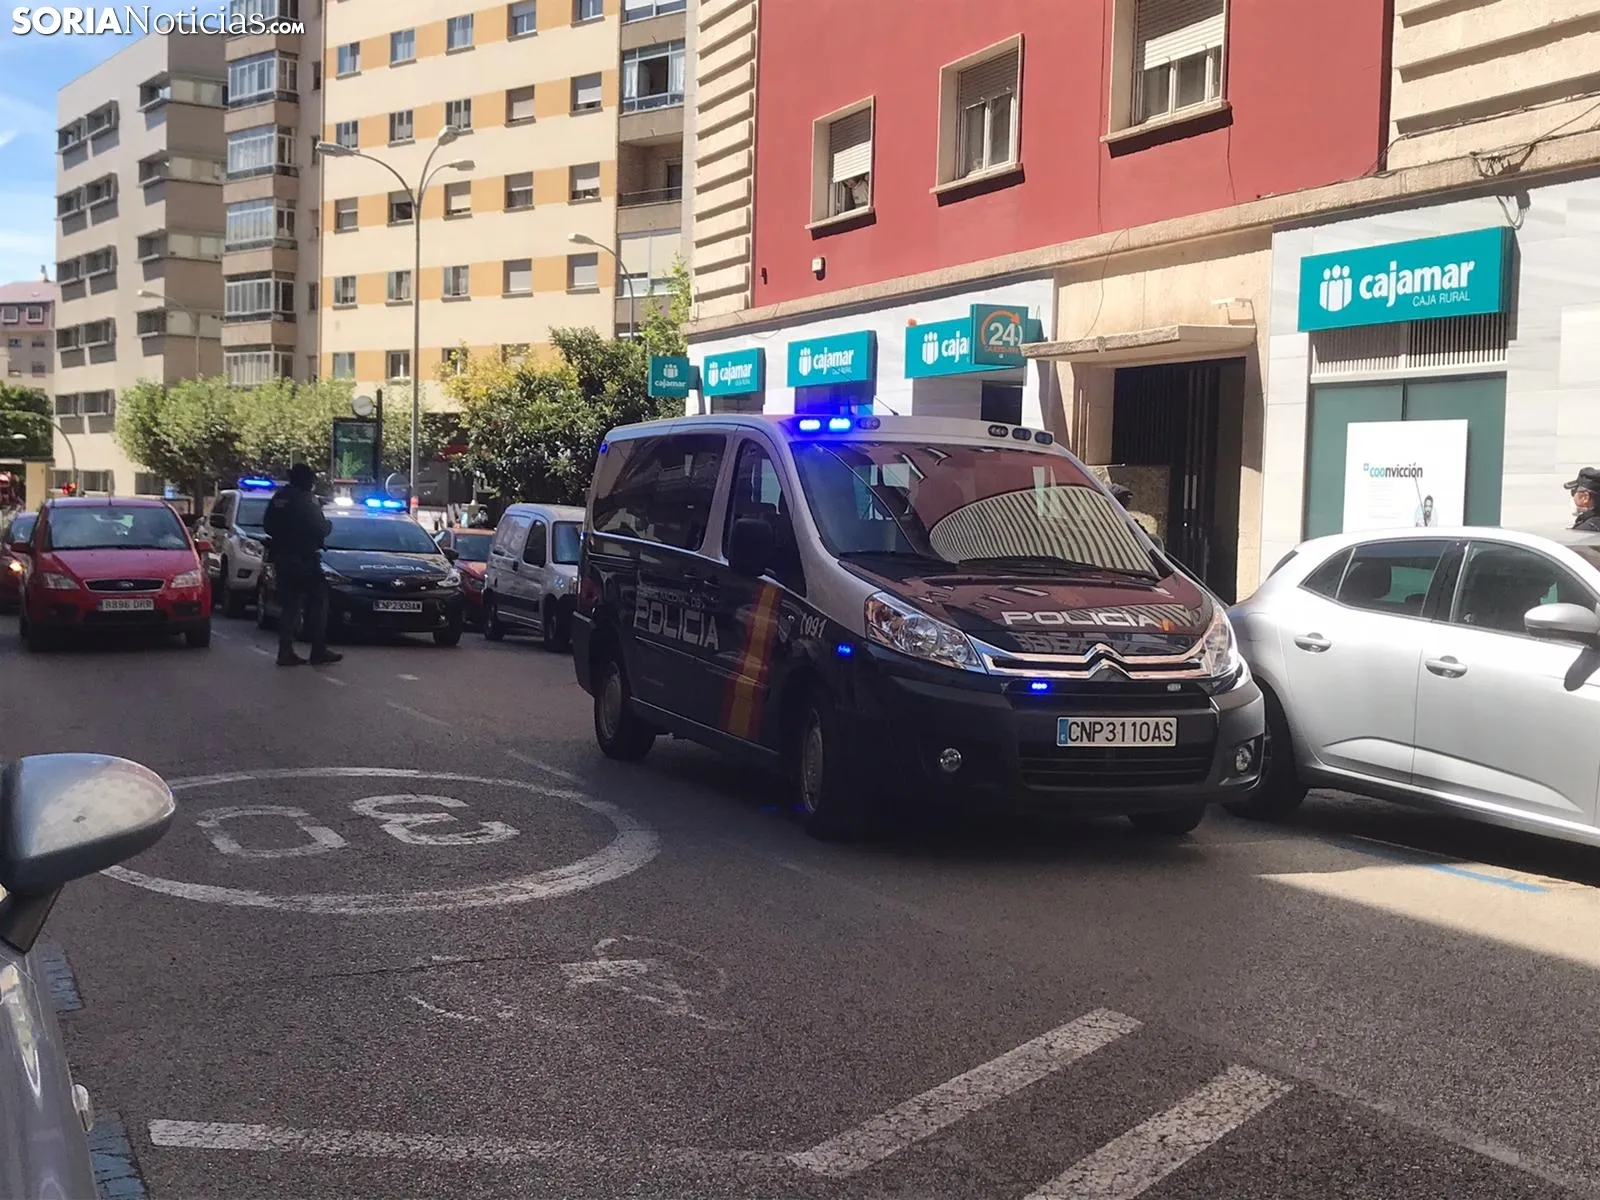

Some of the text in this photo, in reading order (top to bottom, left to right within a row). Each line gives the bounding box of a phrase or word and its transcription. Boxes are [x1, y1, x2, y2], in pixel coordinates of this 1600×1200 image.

[1358, 260, 1476, 308] cajamar
[1412, 292, 1471, 307] CAJA RURAL
[941, 330, 970, 363] caja
[813, 346, 855, 375] cajamar
[654, 379, 686, 388] cajamar
[720, 361, 753, 386] cajamar
[1369, 462, 1423, 478] coonvicción
[1068, 721, 1173, 742] CNP3110AS
